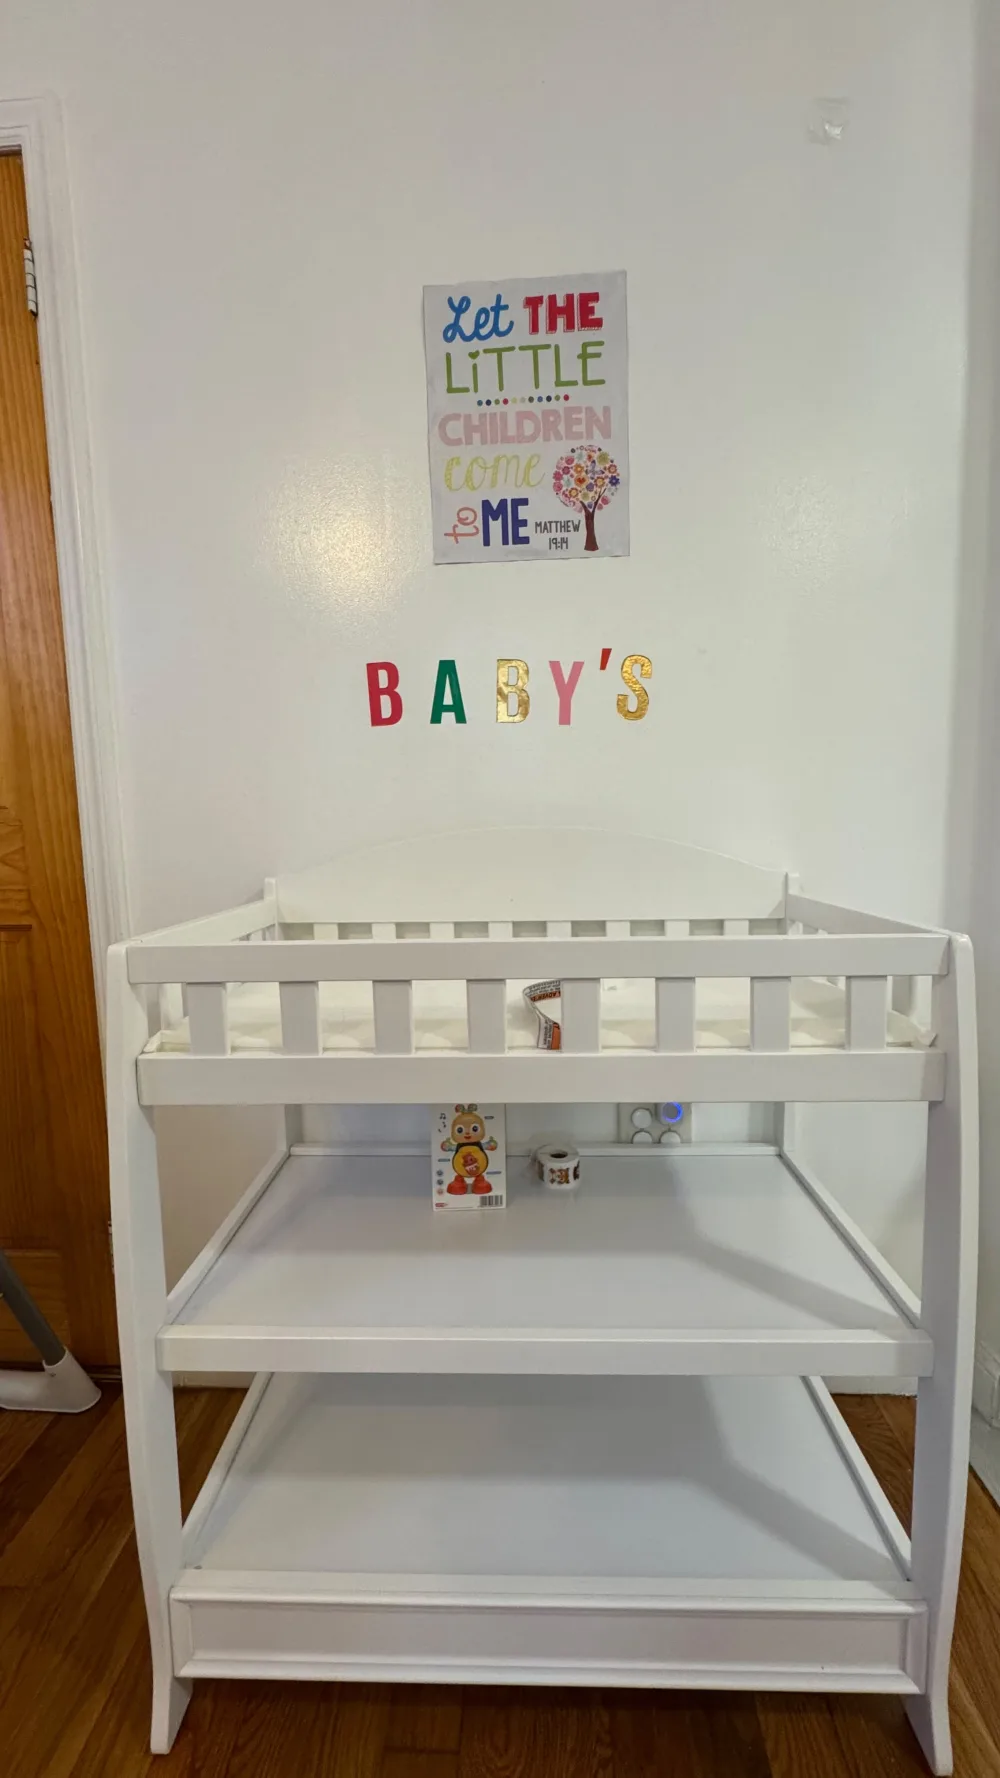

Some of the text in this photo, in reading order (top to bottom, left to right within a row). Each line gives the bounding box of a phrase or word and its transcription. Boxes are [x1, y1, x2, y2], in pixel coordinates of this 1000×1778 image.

[443, 292, 603, 343] Let THE
[438, 406, 611, 446] CHILDREN
[444, 454, 545, 492] come
[444, 498, 530, 546] to ME
[534, 520, 581, 533] MATTHEW
[548, 537, 569, 550] 19:14
[366, 648, 653, 726] BABY'S
